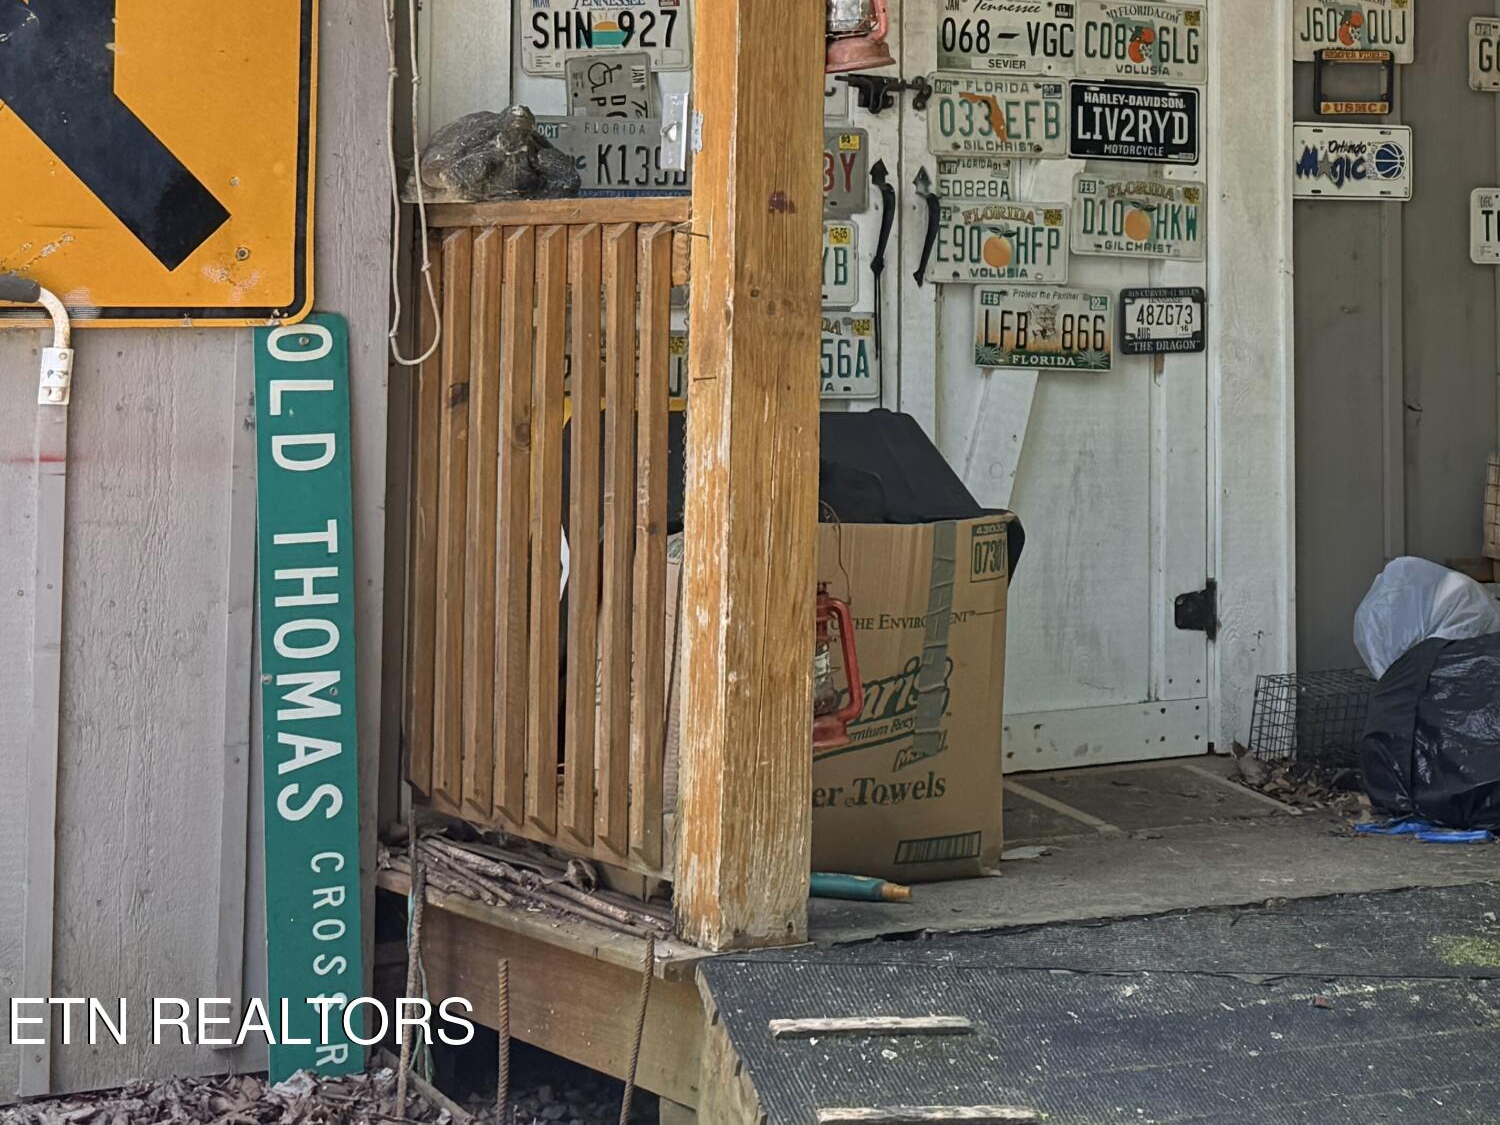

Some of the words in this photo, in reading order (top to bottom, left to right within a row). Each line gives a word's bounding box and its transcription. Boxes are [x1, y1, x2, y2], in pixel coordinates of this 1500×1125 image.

[945, 0, 959, 11] JAN
[532, 10, 593, 49] SHN
[617, 10, 677, 48] 927
[1300, 6, 1337, 42] J60
[942, 17, 990, 54] 068
[1027, 21, 1074, 58] VGC
[1085, 21, 1126, 59] C08
[1159, 27, 1199, 64] 6LG
[988, 59, 1026, 69] SEVIER
[1116, 65, 1170, 75] VOLUSIA
[632, 69, 645, 83] JAN
[966, 81, 1029, 93] FLORIDA
[1084, 92, 1184, 108] HARLEY-DAVIDSON
[1334, 104, 1377, 112] USMC
[940, 98, 992, 137] 033
[1006, 101, 1059, 139] EFB
[1078, 105, 1189, 145] LIV2RYD
[584, 124, 646, 135] FLORIDA
[964, 140, 1034, 152] GILCHRIST
[1104, 144, 1164, 156] MOTORCYCLE
[940, 180, 1010, 199] 50828A
[1106, 181, 1175, 201] FLORIDA
[962, 206, 1035, 225] FLORIDA
[1083, 198, 1123, 236] D10
[1156, 203, 1197, 241] HKW
[937, 225, 981, 263] E90
[1016, 226, 1059, 265] HFP
[1105, 240, 1172, 253] GILCHRIST
[970, 268, 1028, 278] VOLUSIA
[1137, 304, 1192, 325] 48ZG73
[984, 309, 1028, 350] LFB
[1062, 314, 1105, 351] 866
[1137, 327, 1151, 339] AUG
[1013, 355, 1075, 365] FLORIDA
[266, 324, 337, 472] OLD
[271, 518, 344, 822] THOMAS
[852, 771, 946, 805] Towels
